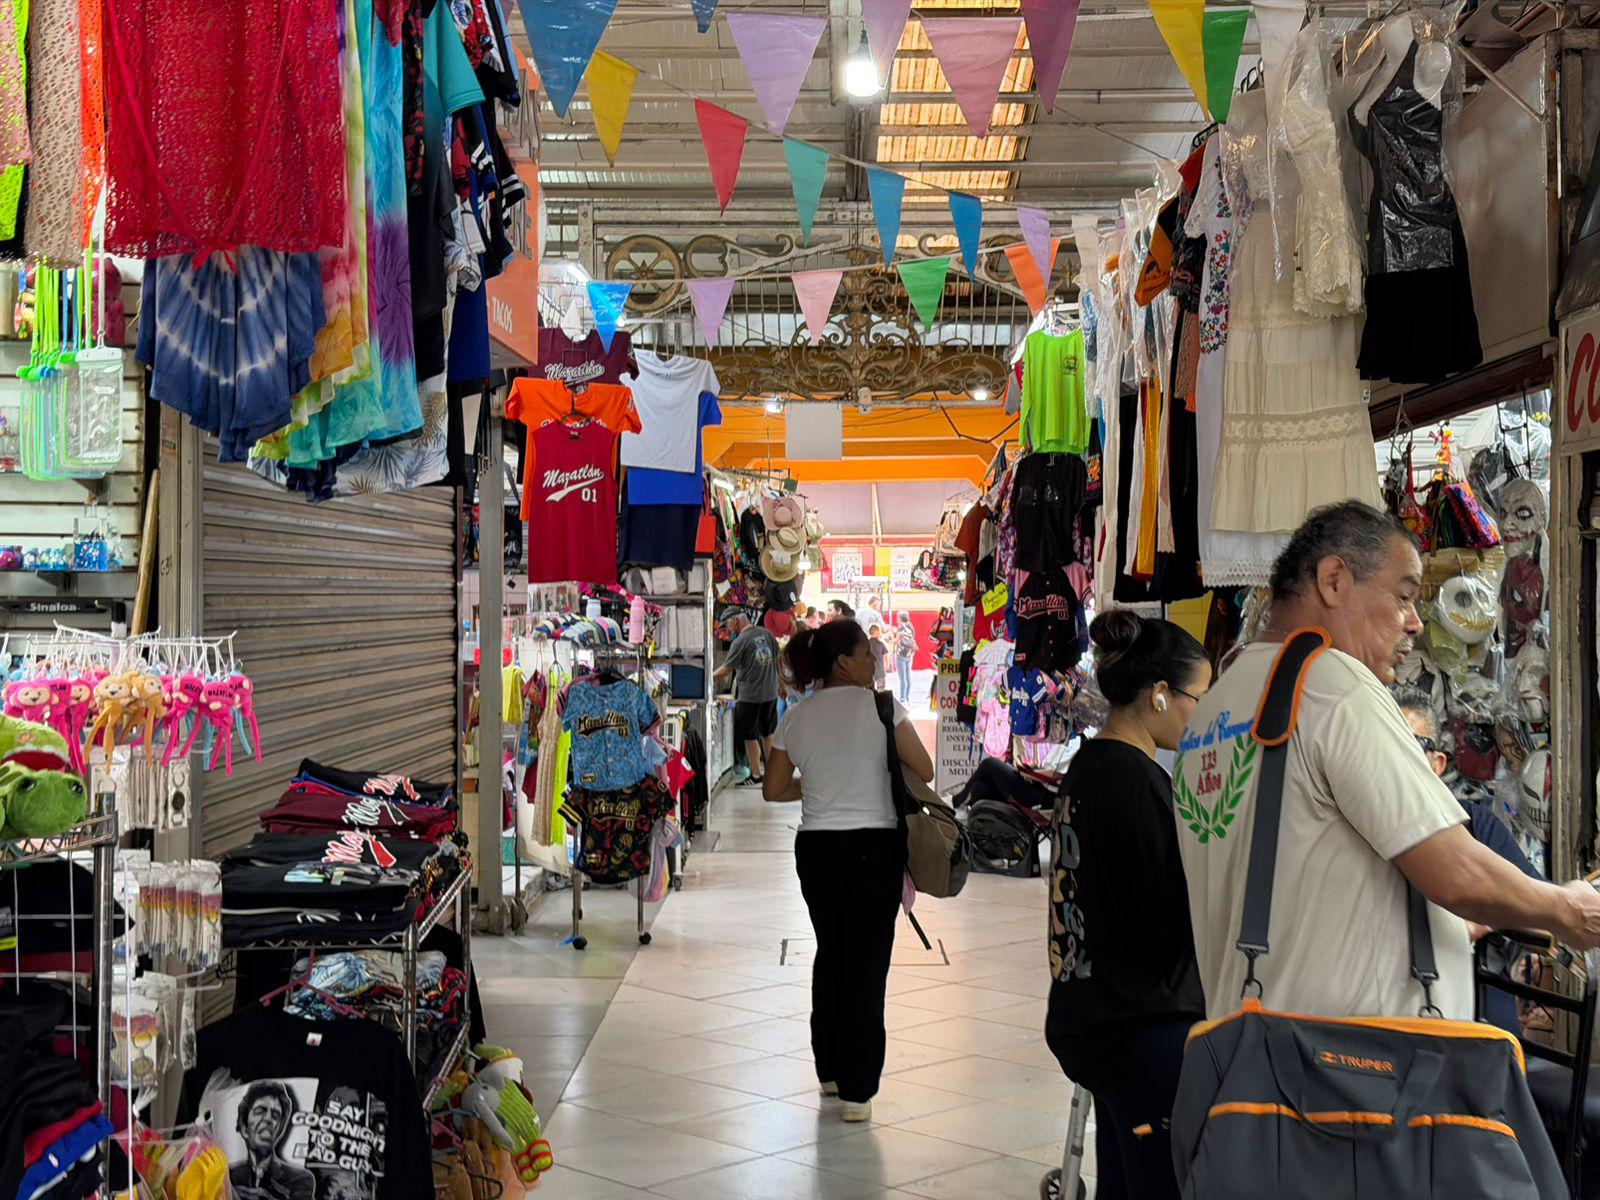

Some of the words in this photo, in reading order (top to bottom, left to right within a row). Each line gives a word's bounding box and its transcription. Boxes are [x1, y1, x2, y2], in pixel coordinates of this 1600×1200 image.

[491, 297, 513, 334] TACOS
[543, 464, 603, 489] Mazatlán
[581, 488, 598, 503] 01
[29, 602, 77, 612] Sinaloa
[326, 1100, 365, 1122] SAY
[293, 1143, 336, 1163] BAD
[309, 1129, 335, 1146] TO
[340, 1136, 371, 1158] THE
